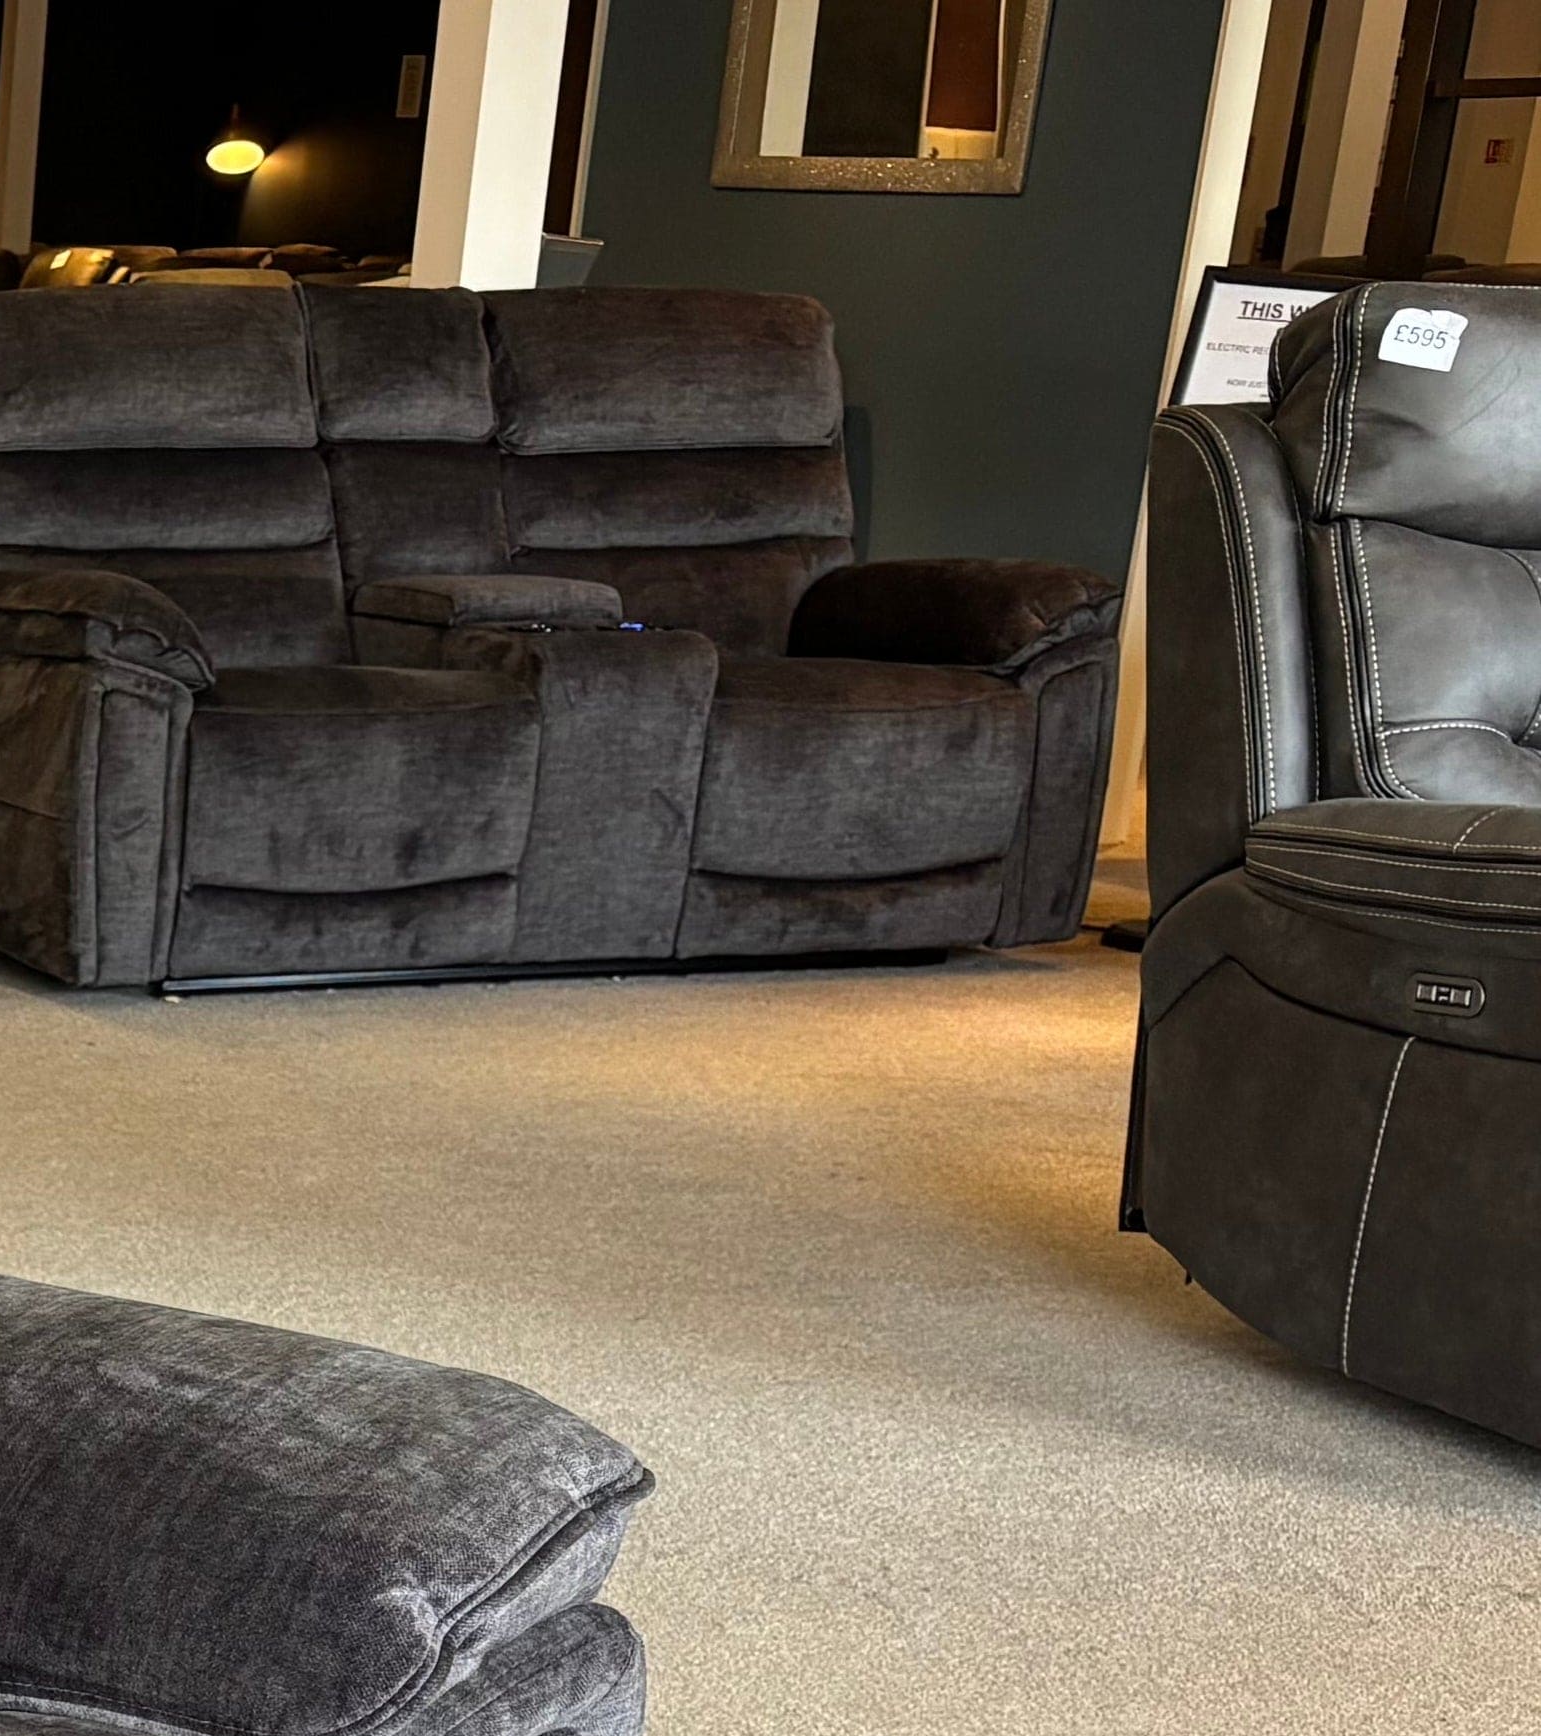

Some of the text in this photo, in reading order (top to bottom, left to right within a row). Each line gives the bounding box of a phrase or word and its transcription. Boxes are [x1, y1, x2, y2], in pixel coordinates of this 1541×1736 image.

[1240, 300, 1283, 319] THIS
[1393, 323, 1449, 350] £595
[1206, 342, 1251, 355] ELECTRIC
